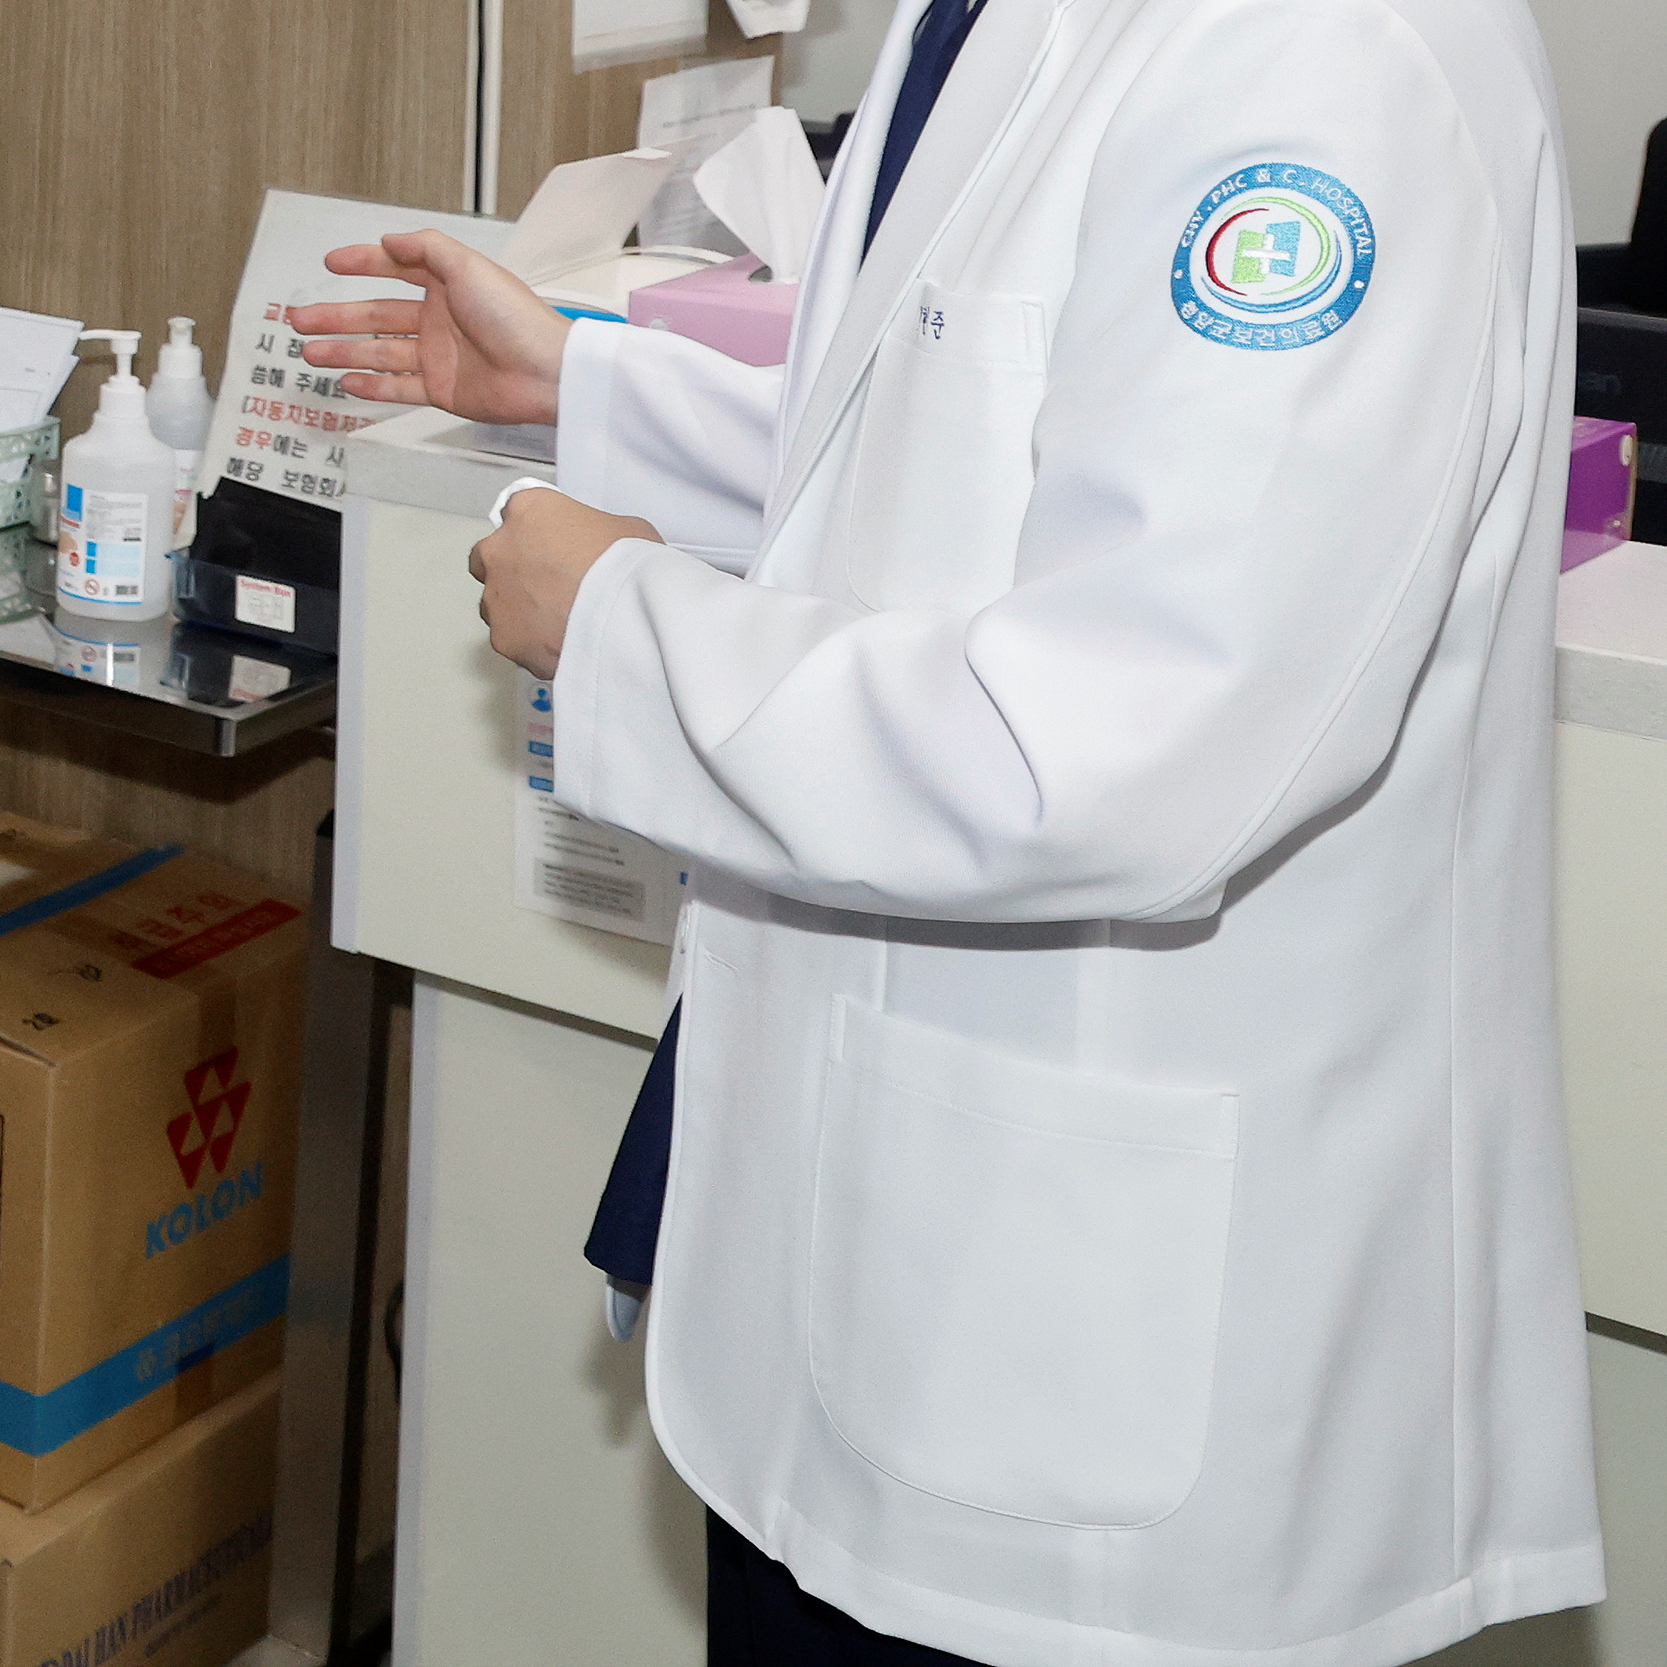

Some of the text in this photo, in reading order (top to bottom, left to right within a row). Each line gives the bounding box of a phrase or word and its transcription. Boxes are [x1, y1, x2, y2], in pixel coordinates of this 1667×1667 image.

[1210, 173, 1248, 204] PHC
[1256, 167, 1272, 184] &
[1315, 177, 1373, 256] HOSPITAL
[226, 456, 264, 483] 해당
[235, 425, 309, 460] 경우에는
[144, 1161, 264, 1260] KOLON
